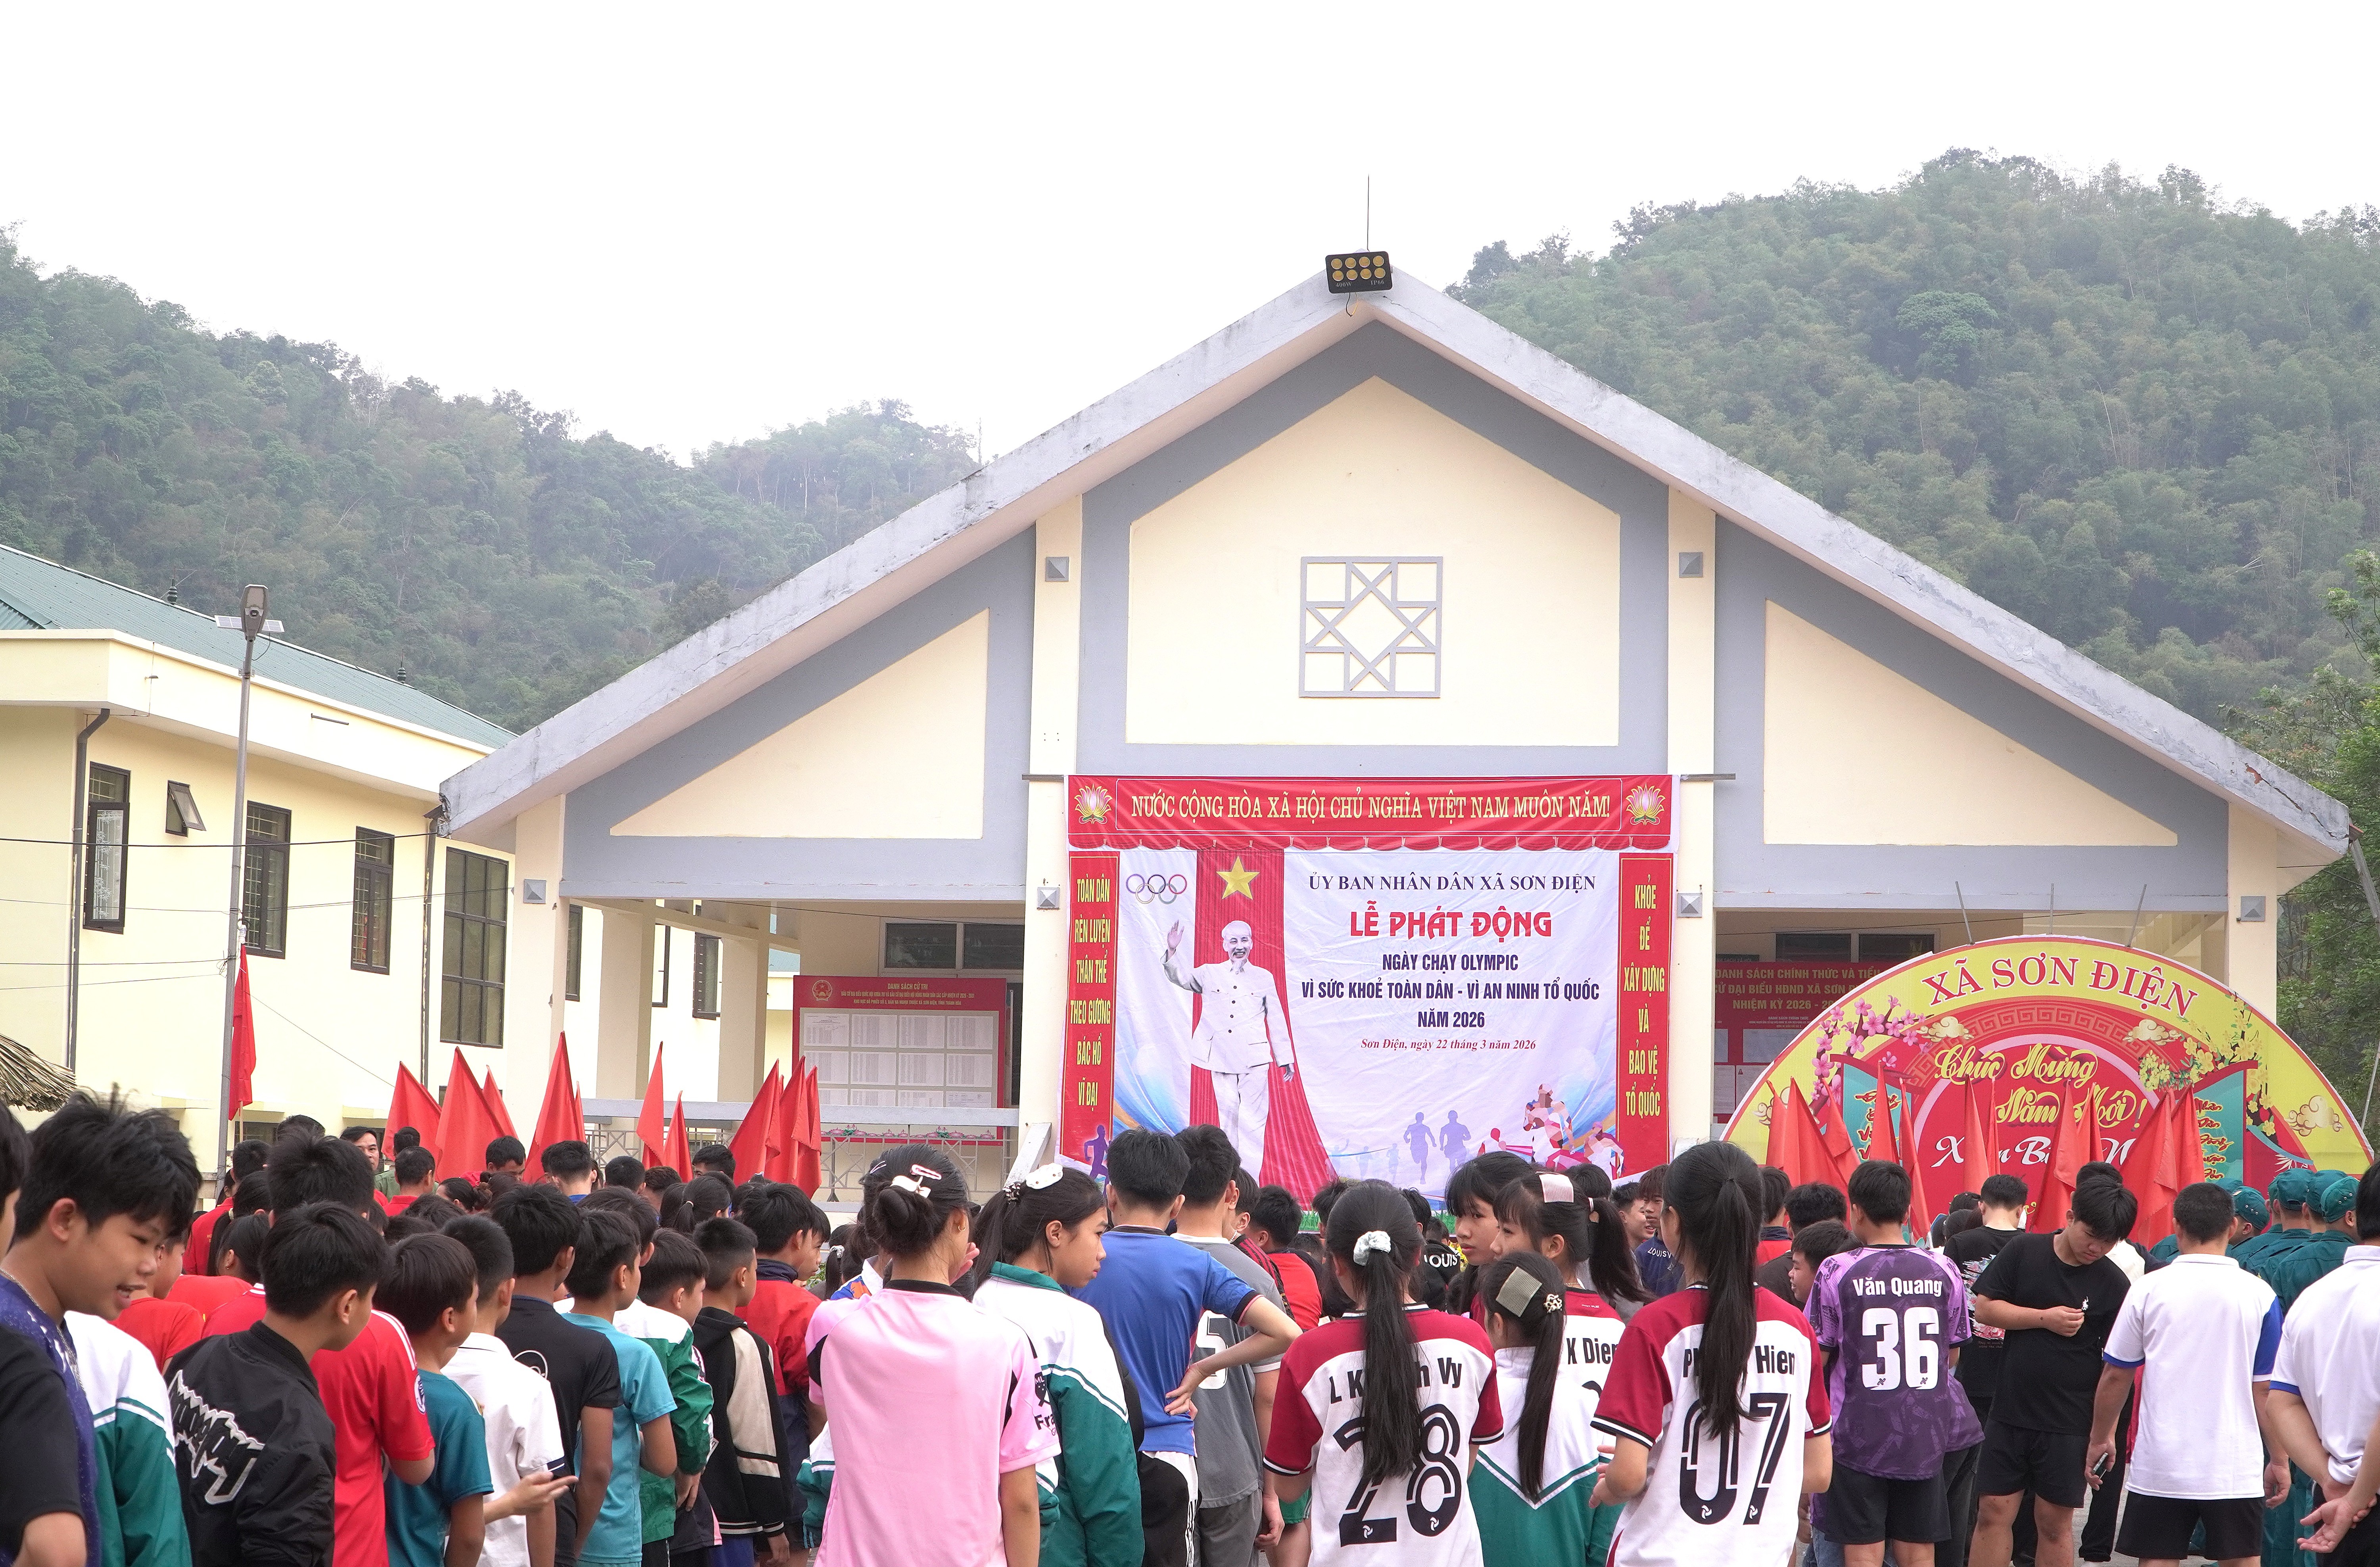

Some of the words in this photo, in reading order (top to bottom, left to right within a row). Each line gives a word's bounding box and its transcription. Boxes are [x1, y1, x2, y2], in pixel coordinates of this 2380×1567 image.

[1131, 788, 1175, 817] NƯỚC
[1179, 788, 1223, 824] CỘNG
[1228, 788, 1262, 818] HÒA
[1267, 791, 1292, 818] XÃ
[1296, 789, 1326, 824] HỘI
[1330, 786, 1364, 818] CHỦ
[1368, 791, 1422, 818] NGHĨA
[1427, 789, 1466, 824] VIỆT
[1470, 796, 1509, 818] NAM
[1513, 788, 1564, 818] MUÔN
[1568, 789, 1610, 818] NĂM!
[1077, 873, 1095, 903] TOÀN
[1096, 873, 1110, 903] DÂN
[1309, 871, 1334, 890] ỦY
[1338, 876, 1374, 890] BAN
[1380, 871, 1432, 890] NHÂN
[1436, 871, 1475, 890] DÂN
[1480, 872, 1505, 890] XÃ
[1510, 874, 1547, 890] SƠN
[1551, 871, 1596, 894] ĐIỆN
[1635, 874, 1656, 909] KHỎE
[1074, 914, 1088, 943] RÈN
[1090, 914, 1111, 948] LUYỆN
[1350, 900, 1380, 937] LỄ
[1390, 905, 1463, 940] PHÁT
[1470, 905, 1552, 943] ĐỘNG
[1639, 916, 1651, 951] ĐỂ
[1076, 954, 1094, 983] THÂN
[1095, 949, 1108, 983] THỂ
[1382, 951, 1417, 971] NGÀY
[1422, 954, 1456, 974] CHẠY
[1461, 954, 1518, 971] OLYMPIC
[1715, 969, 1743, 978] DANH
[1747, 968, 1774, 978] SÁCH
[1777, 968, 1809, 978] CHÍNH
[1812, 968, 1839, 978] THỨC
[1842, 968, 1855, 978] VÀ
[1302, 980, 1314, 999] VÌ
[1318, 978, 1345, 999] SỨC
[1348, 977, 1383, 999] KHOẺ
[1388, 979, 1422, 999] TOÀN
[1427, 979, 1454, 999] DÂN
[1466, 980, 1480, 999] VÌ
[1483, 983, 1502, 999] AN
[1507, 983, 1539, 999] NINH
[1544, 976, 1560, 999] TỔ
[1564, 977, 1599, 1001] QUỐC
[1623, 962, 1640, 992] XÂY
[1642, 965, 1665, 997] DỰNG
[1728, 984, 1746, 996] ĐẠI
[1749, 982, 1772, 994] BIỂU
[1807, 983, 1821, 994] XÃ
[1824, 984, 1845, 994] SƠN
[1921, 957, 1984, 1007] XÃ
[1990, 952, 2080, 989] SƠN
[2088, 961, 2199, 1018] ĐIỆN
[1070, 1000, 1087, 1024] THEO
[1088, 997, 1111, 1024] GƯƠNG
[1417, 1008, 1449, 1028] NĂM
[1453, 1011, 1485, 1028] 2026
[1638, 1003, 1649, 1033] VÀ
[1733, 999, 1767, 1011] NHIỆM
[1770, 998, 1783, 1009] KỲ
[1786, 1000, 1811, 1009] 2026
[1077, 1036, 1091, 1065] BÁC
[1092, 1033, 1102, 1065] HỒ
[1361, 1039, 1380, 1048] Sơn
[1382, 1039, 1407, 1051] Điện,
[1410, 1039, 1434, 1051] ngày
[1436, 1040, 1448, 1049] 22
[1450, 1040, 1478, 1051] tháng
[1480, 1040, 1486, 1049] 3
[1489, 1040, 1510, 1049] năm
[1512, 1040, 1537, 1049] 2026
[1629, 1039, 1646, 1074] BẢO
[1648, 1045, 1658, 1080] VỆ
[1934, 1044, 2005, 1085] Chúc
[2011, 1043, 2098, 1088] Mừng
[1078, 1077, 1085, 1106] VĨ
[1086, 1082, 1098, 1112] ĐẠI
[1626, 1082, 1637, 1116] TỔ
[1638, 1083, 1661, 1119] QUỐC
[1852, 1277, 1886, 1296] Văn
[1891, 1277, 1942, 1297] Quang
[1754, 1345, 1795, 1375] Hien
[1862, 1307, 1940, 1391] 36
[1437, 1357, 1462, 1388] Vy
[1679, 1392, 1791, 1525] 07
[1333, 1404, 1462, 1547] 28
